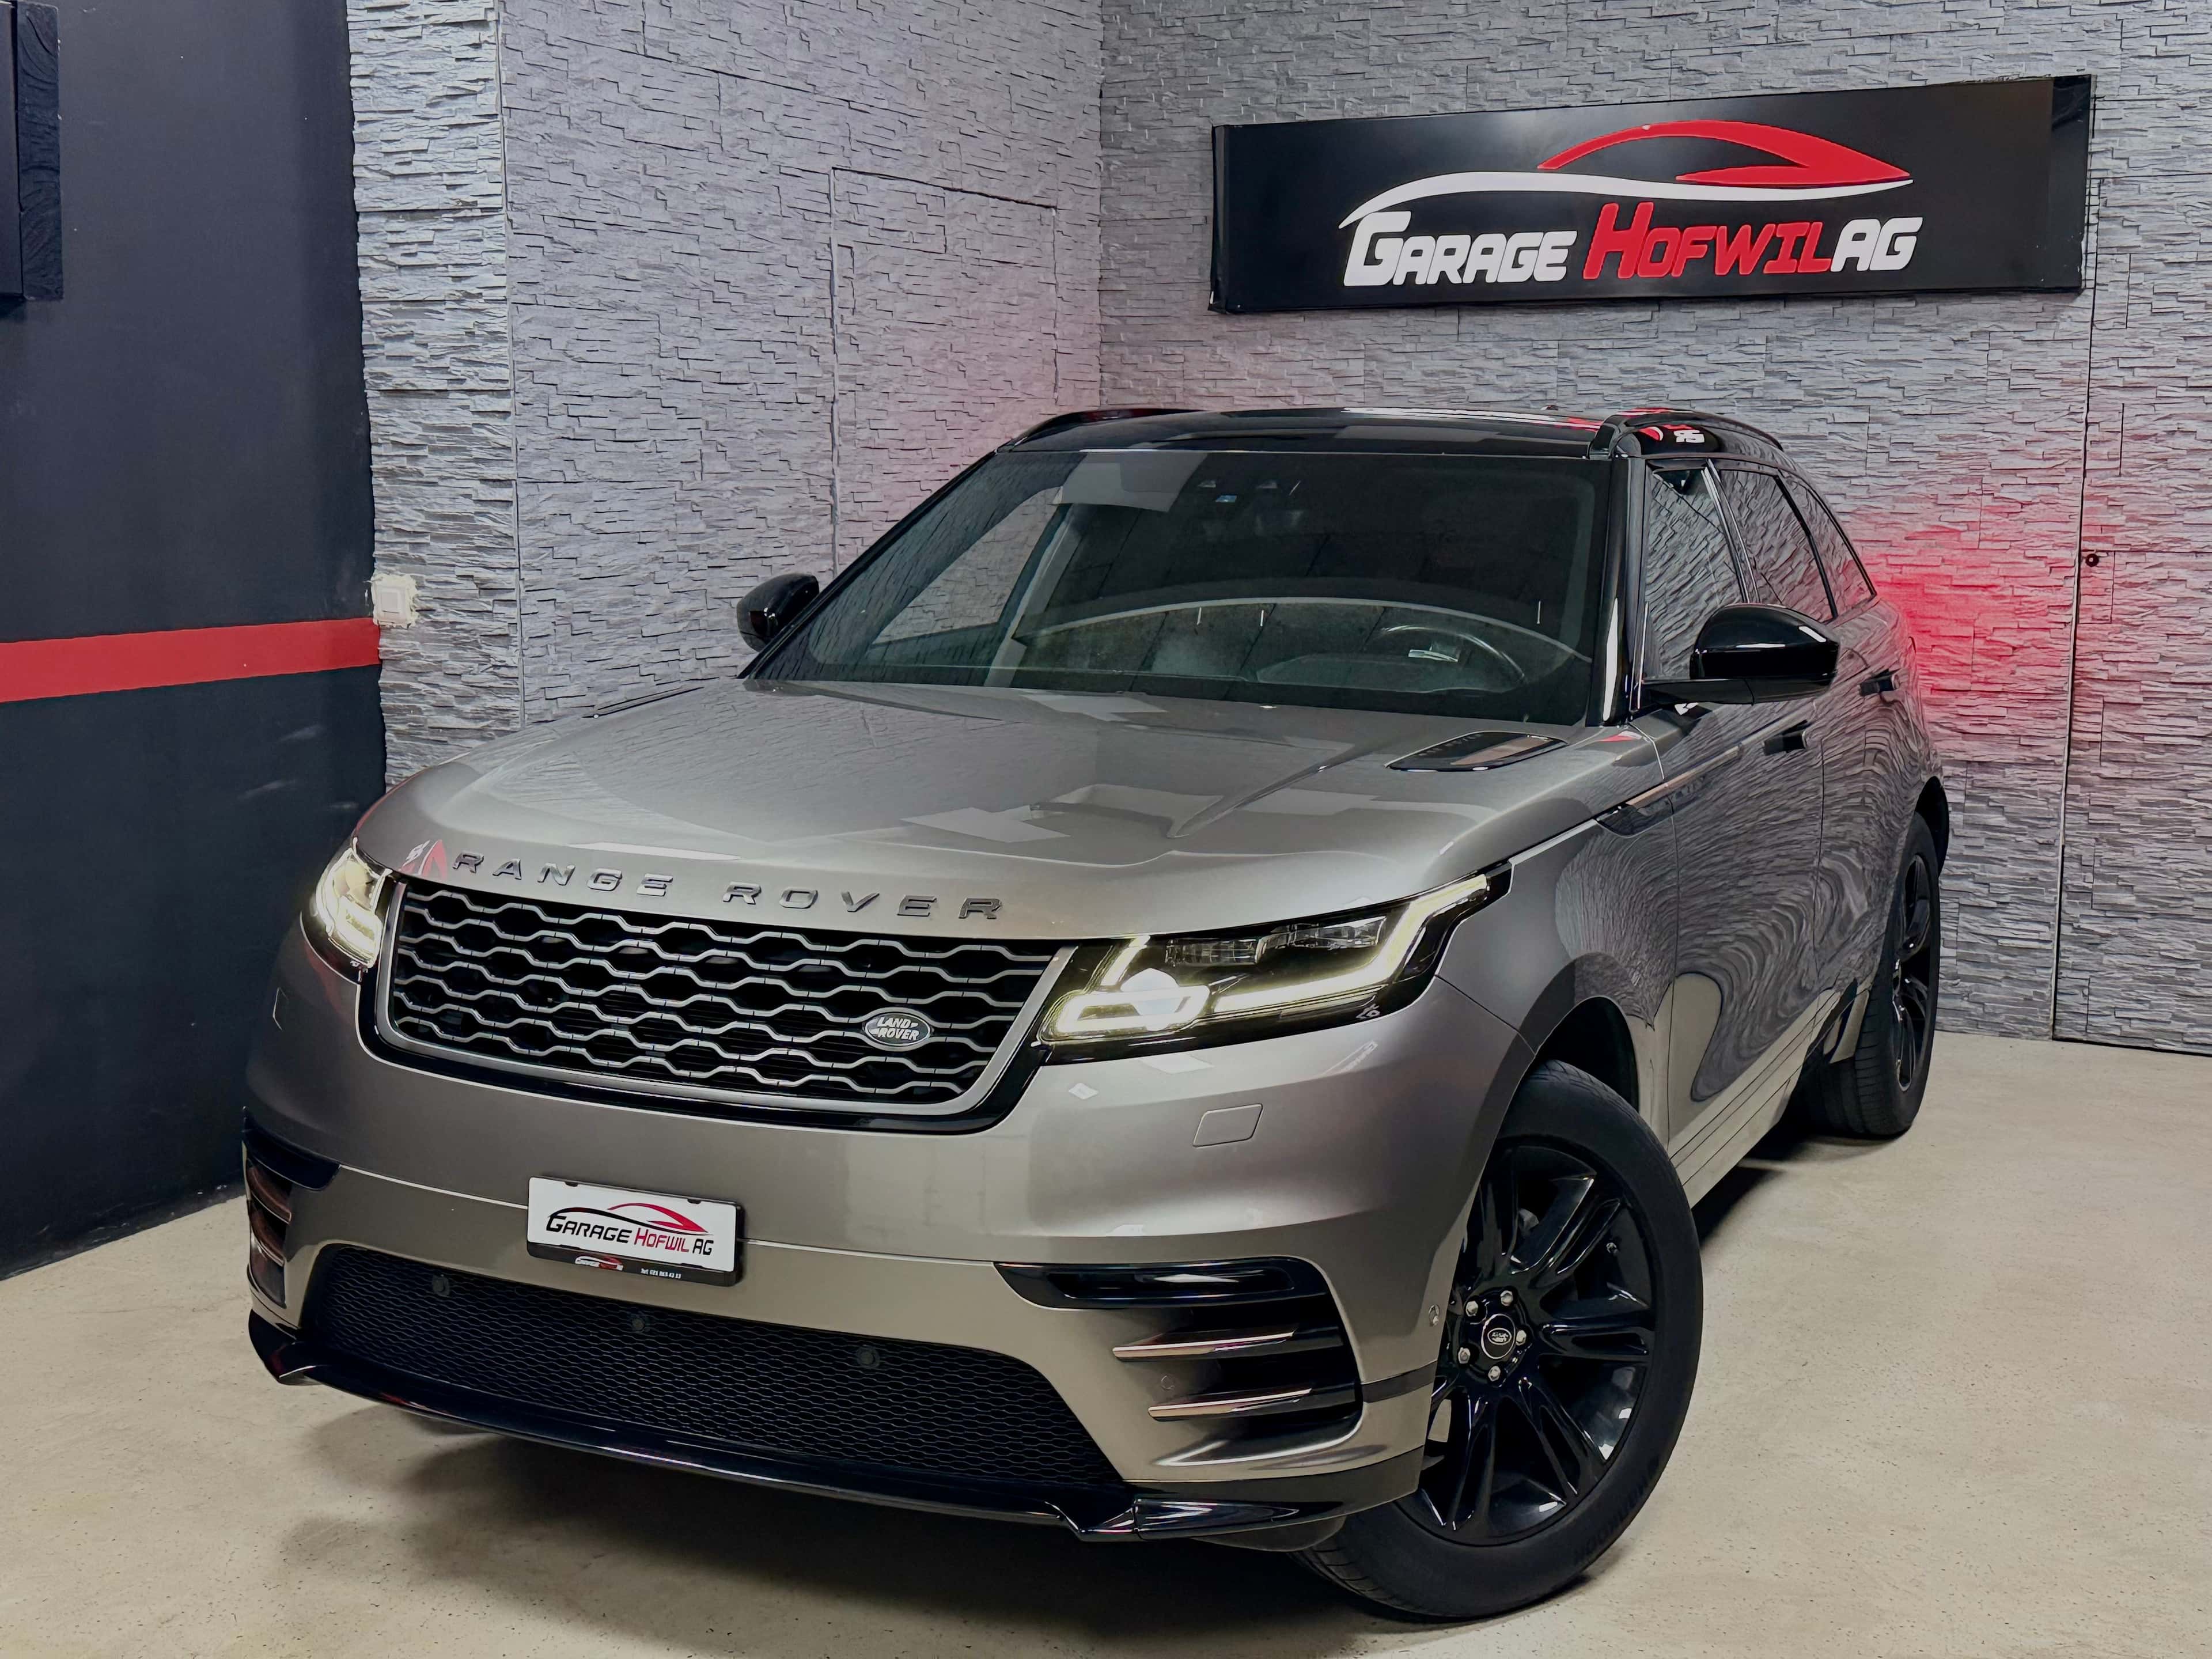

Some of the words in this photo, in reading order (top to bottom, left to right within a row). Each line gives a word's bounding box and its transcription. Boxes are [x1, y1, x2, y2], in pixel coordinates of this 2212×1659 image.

[1344, 211, 1577, 286] GARAGE
[452, 851, 673, 896] RANGE
[722, 881, 1003, 919] ROVER
[877, 1017, 911, 1029] LAND
[877, 1027, 919, 1041] ROVER
[546, 1215, 632, 1244] GARAGE
[634, 1228, 690, 1252] HOFWIL
[692, 1238, 714, 1256] AG
